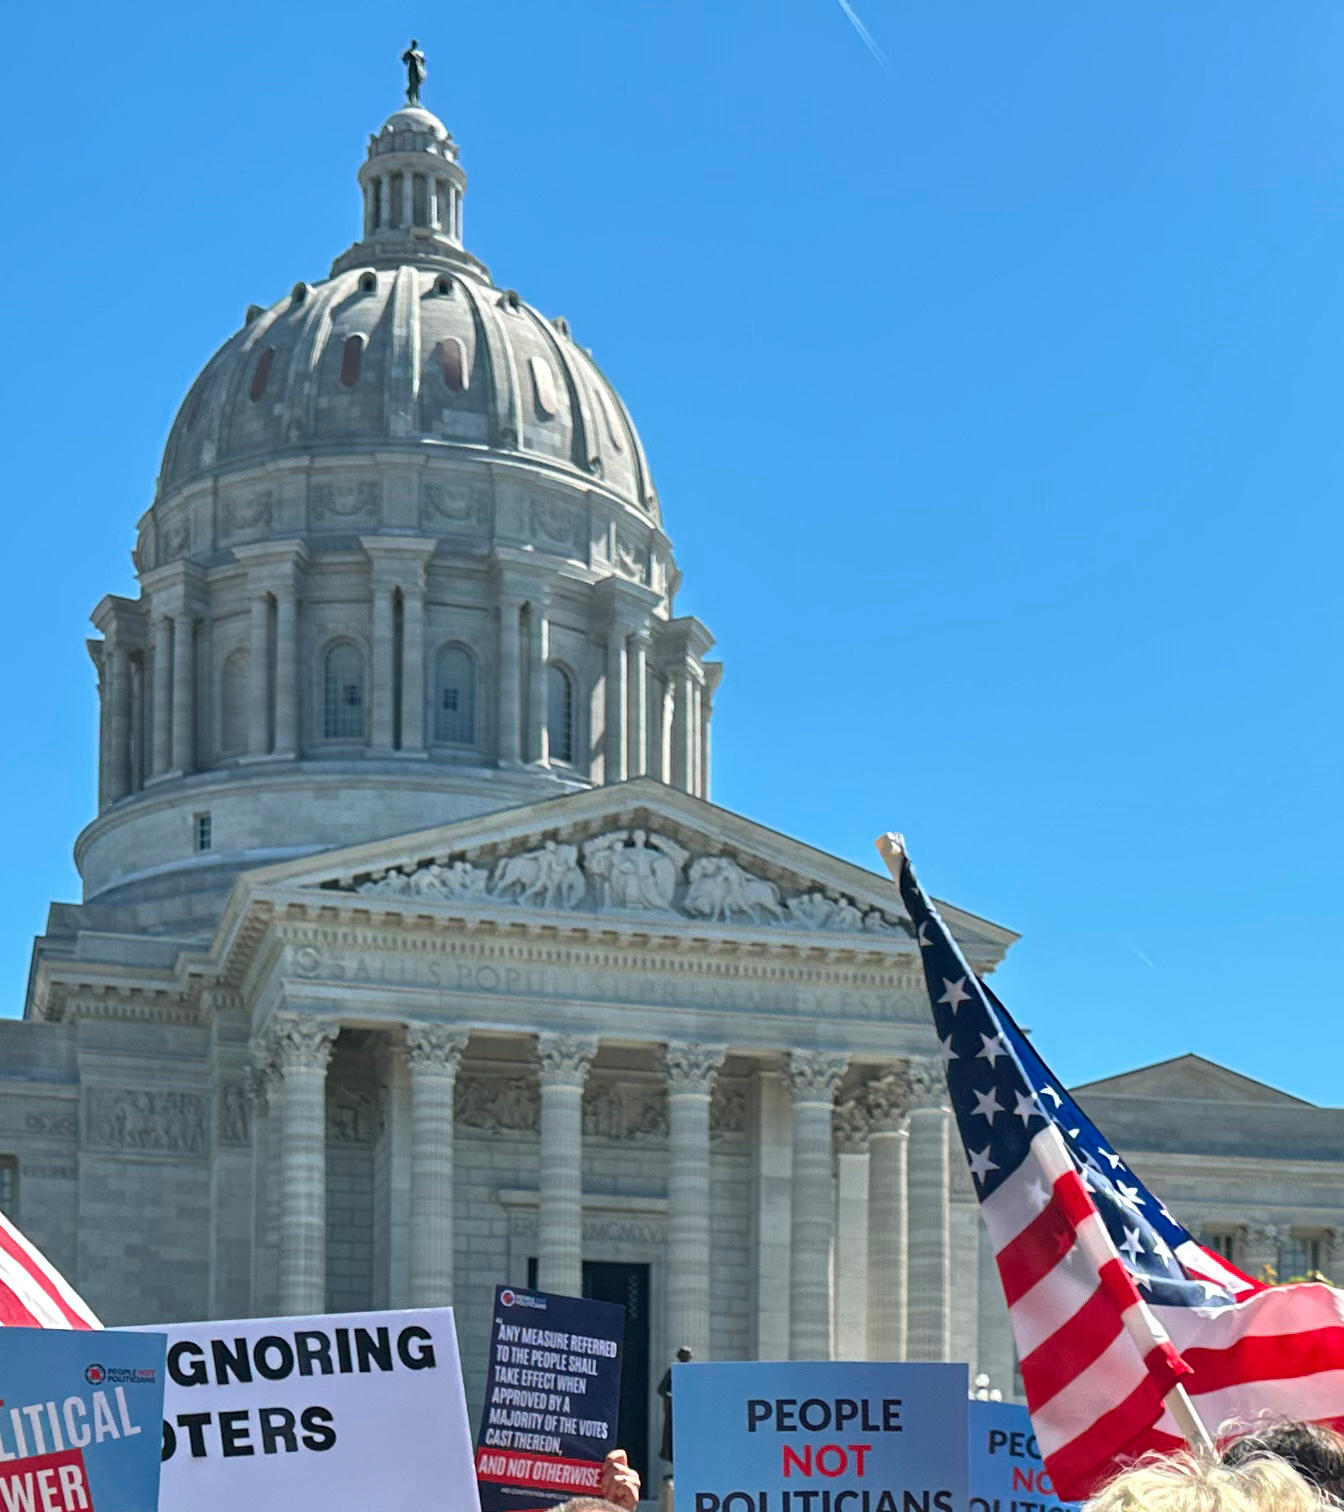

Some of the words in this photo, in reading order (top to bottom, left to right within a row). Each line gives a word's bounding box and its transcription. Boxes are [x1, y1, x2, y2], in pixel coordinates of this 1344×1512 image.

[164, 1326, 436, 1388] GNORING
[521, 1327, 569, 1348] MEASURE
[570, 1335, 617, 1358] REFERRED
[531, 1350, 567, 1371] PEOPLE
[568, 1356, 597, 1375] SHALL
[521, 1369, 556, 1389] EFFECT
[557, 1375, 586, 1394] WHEN
[491, 1387, 547, 1410] APPROVED
[489, 1408, 544, 1431] MAJORITY
[579, 1419, 607, 1439] VOTES
[748, 1399, 903, 1433] PEOPLE
[159, 1406, 337, 1462] TERS
[506, 1458, 531, 1479] NOT
[782, 1445, 872, 1478] NOT
